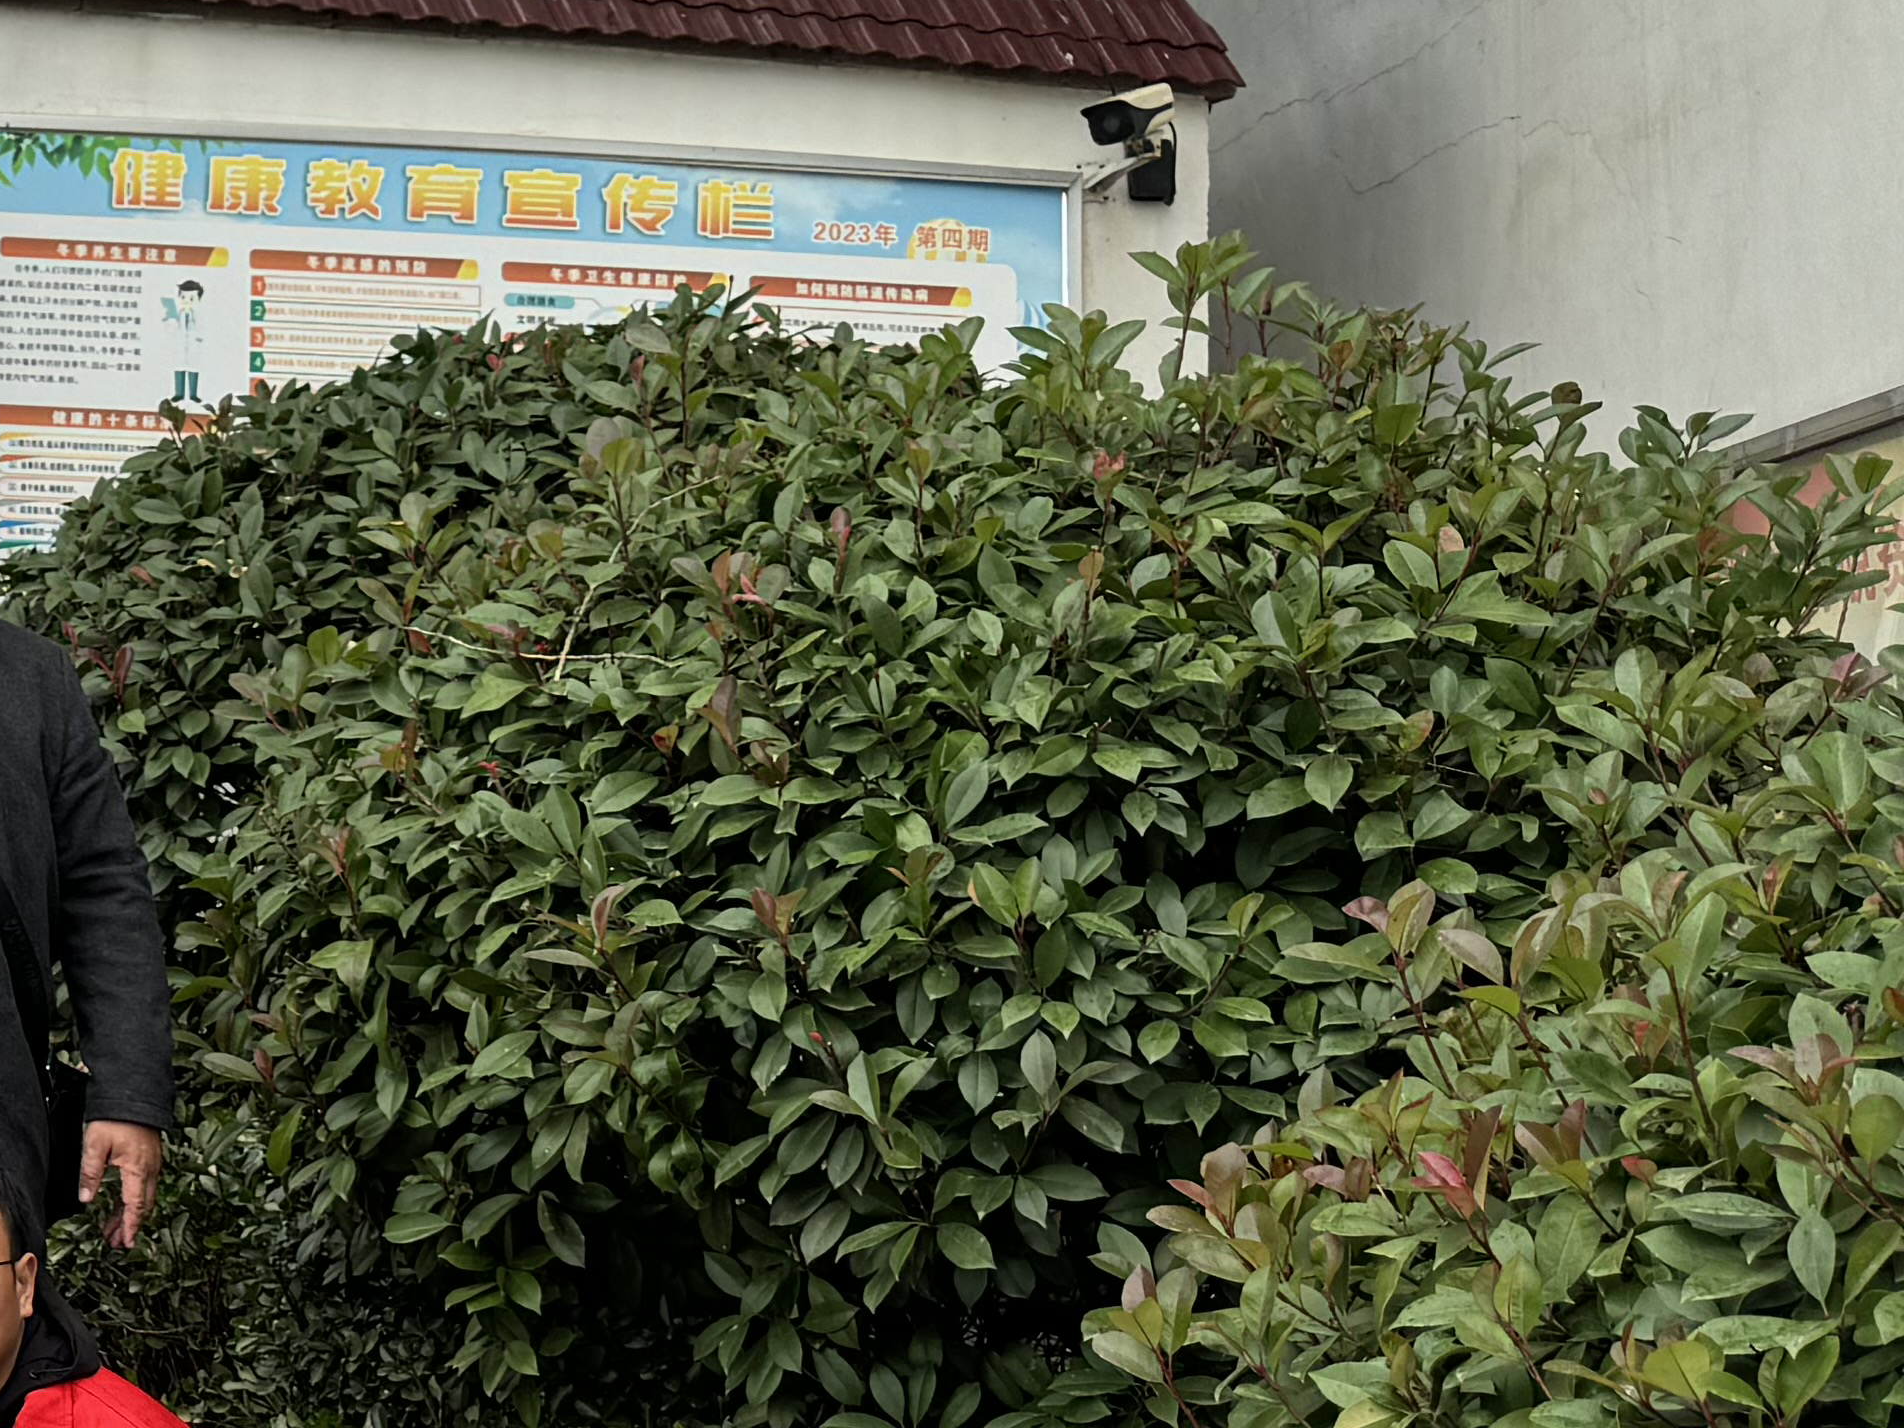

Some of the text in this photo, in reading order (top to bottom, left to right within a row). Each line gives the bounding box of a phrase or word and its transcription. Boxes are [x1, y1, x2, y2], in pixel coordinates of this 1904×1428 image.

[111, 147, 774, 239] 健康教育宣传栏
[812, 222, 991, 253] 2023年 第四期
